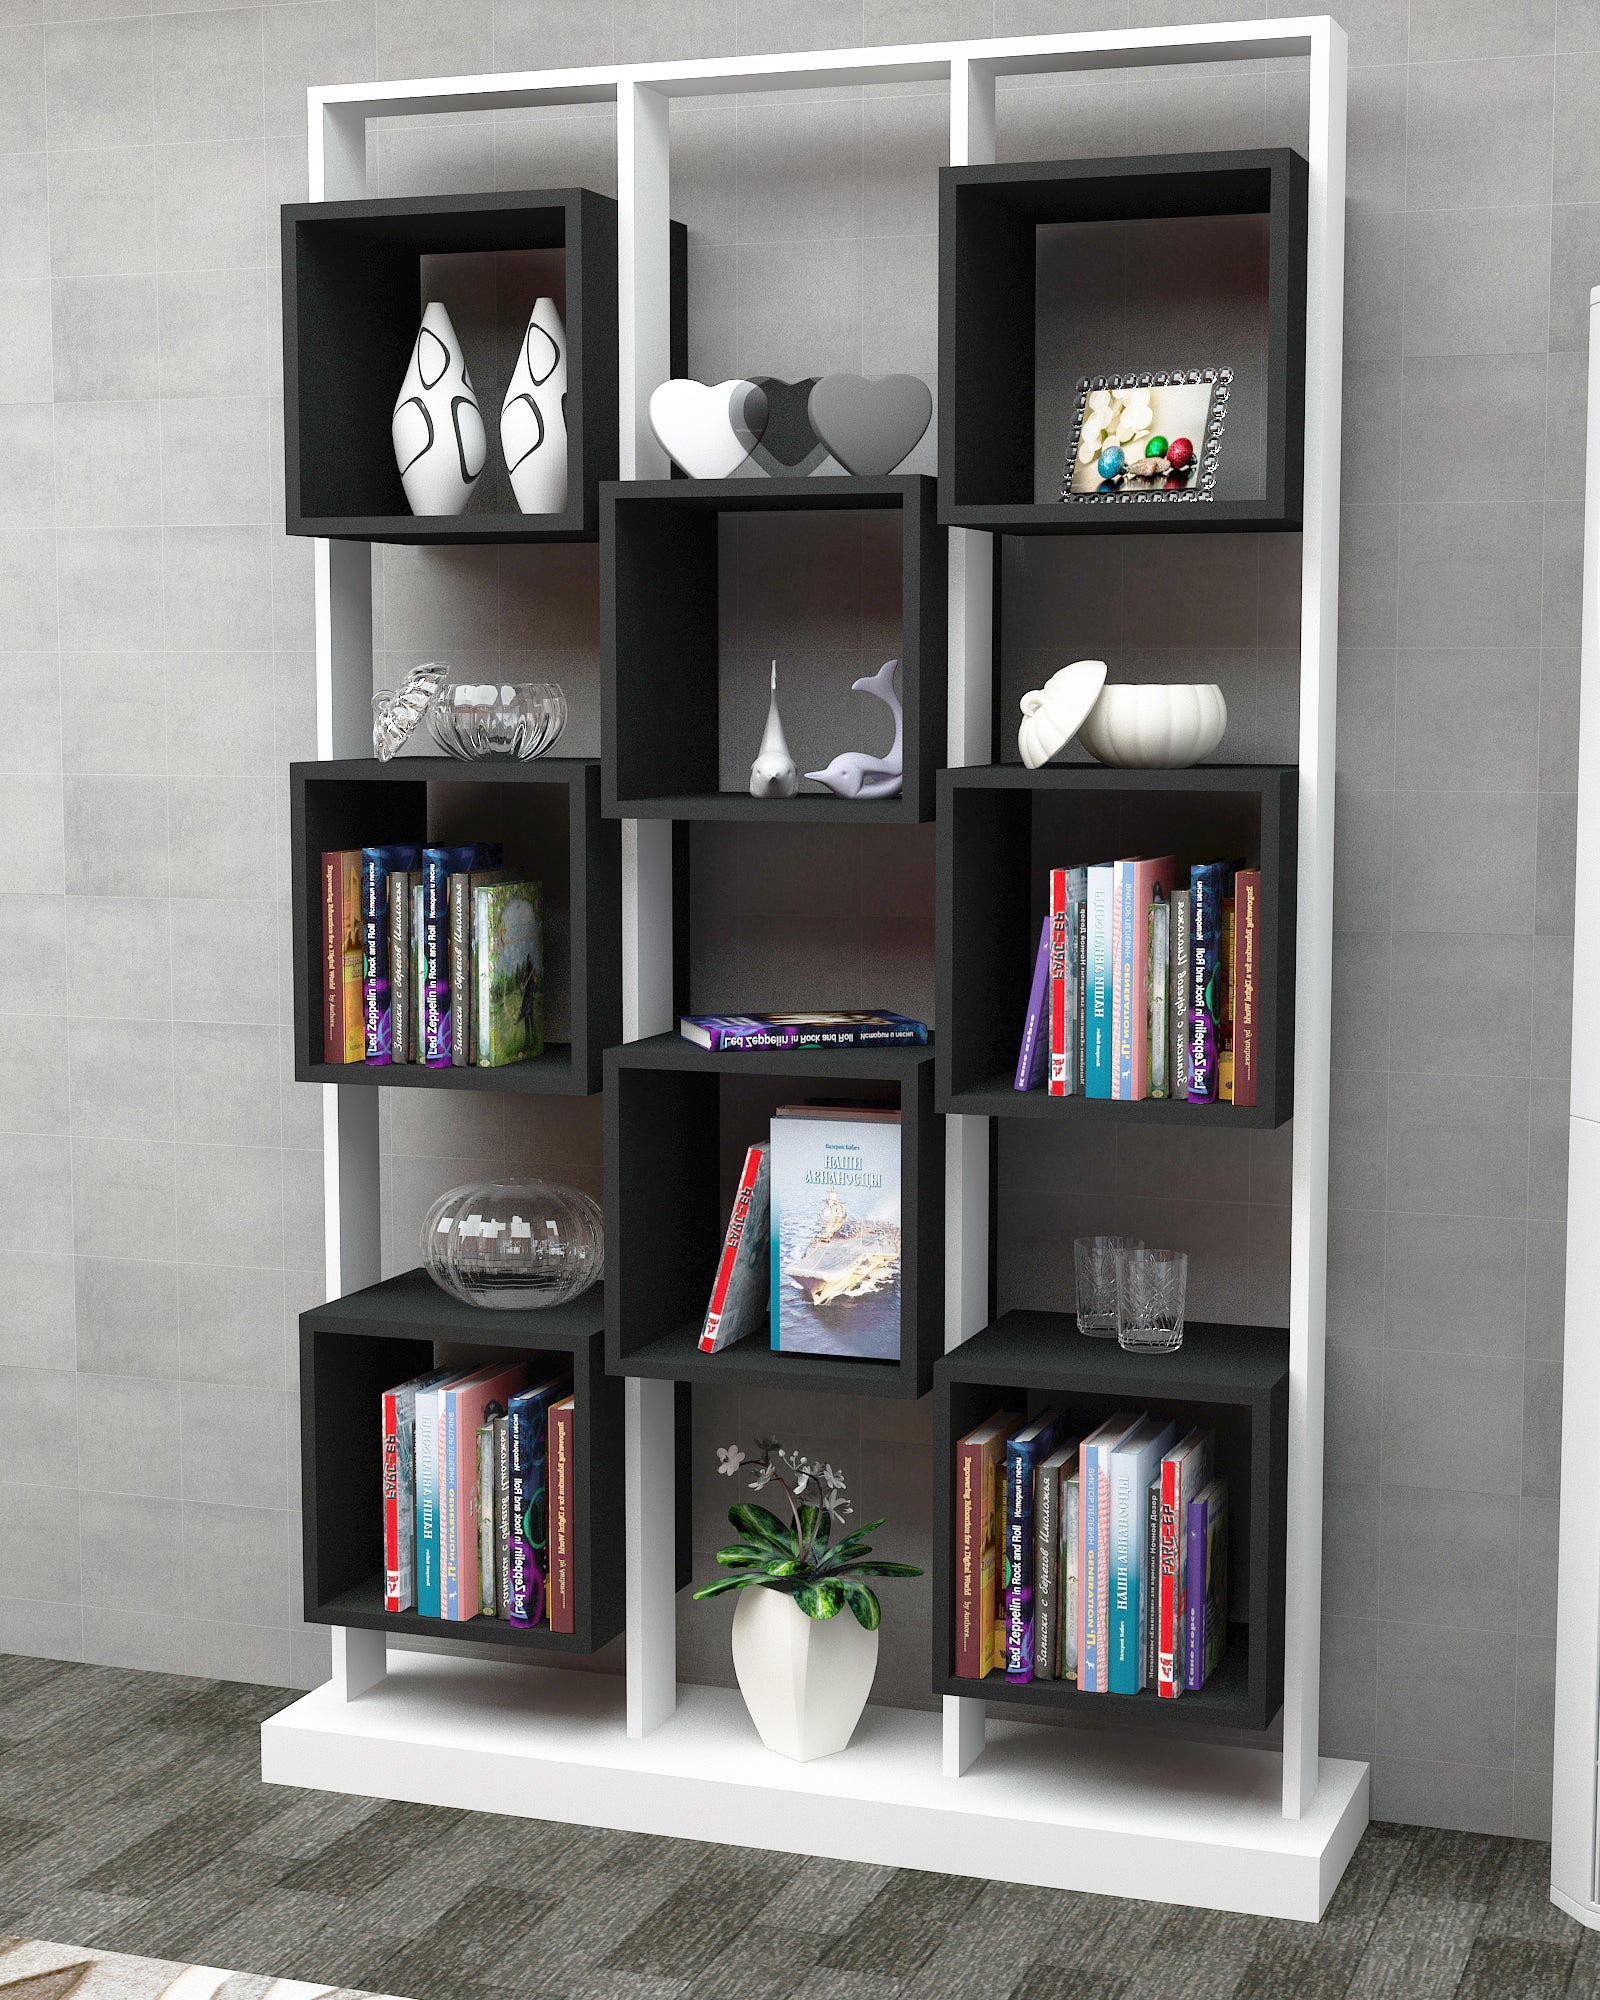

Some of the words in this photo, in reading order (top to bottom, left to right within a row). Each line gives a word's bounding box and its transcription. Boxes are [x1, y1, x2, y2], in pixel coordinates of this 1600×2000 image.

[326, 865, 334, 903] Empowering
[368, 888, 377, 916] История
[429, 889, 438, 918] История
[327, 904, 335, 934] Education
[367, 924, 376, 939] Roll
[427, 925, 437, 940] Roll
[327, 950, 336, 969] Digital
[367, 941, 377, 955] and
[427, 942, 437, 957] and
[367, 957, 377, 977] Rock
[393, 945, 405, 987] берегов
[427, 959, 437, 979] Rock
[454, 947, 465, 989] берегов
[328, 970, 336, 989] World
[328, 994, 336, 1002] by
[366, 989, 380, 1032] Zeppelin
[426, 991, 440, 1034] Zeppelin
[393, 1004, 403, 1052] Записки
[453, 1006, 463, 1054] Записки
[366, 1033, 377, 1052] Led
[426, 1035, 437, 1055] Led
[824, 1155, 863, 1170] НАШИ
[804, 1169, 882, 1189] АВИАНОСЦЫ
[963, 1457, 972, 1499] Empowering
[1015, 1457, 1023, 1478] песни
[1087, 1469, 1096, 1503] ВИКТОР
[1013, 1485, 1024, 1517] История
[1150, 1495, 1158, 1521] Дозор
[964, 1500, 973, 1533] Education
[1087, 1505, 1095, 1544] ПЕЛЕВИН
[1118, 1477, 1130, 1563] АВИАНОСЦЫ
[964, 1535, 972, 1545] for
[1011, 1525, 1022, 1542] Roll
[1149, 1523, 1157, 1553] Ночной
[962, 1551, 972, 1573] Digital
[1011, 1544, 1022, 1561] and
[1011, 1563, 1022, 1584] Rock
[1038, 1548, 1051, 1594] берегов
[963, 1575, 972, 1595] World
[1087, 1550, 1095, 1627] GENERATION
[1117, 1568, 1128, 1609] НАШИ
[964, 1601, 972, 1610] by
[1008, 1598, 1023, 1645] Zeppelin
[1036, 1613, 1048, 1666] Записки
[1009, 1647, 1020, 1669] Led
